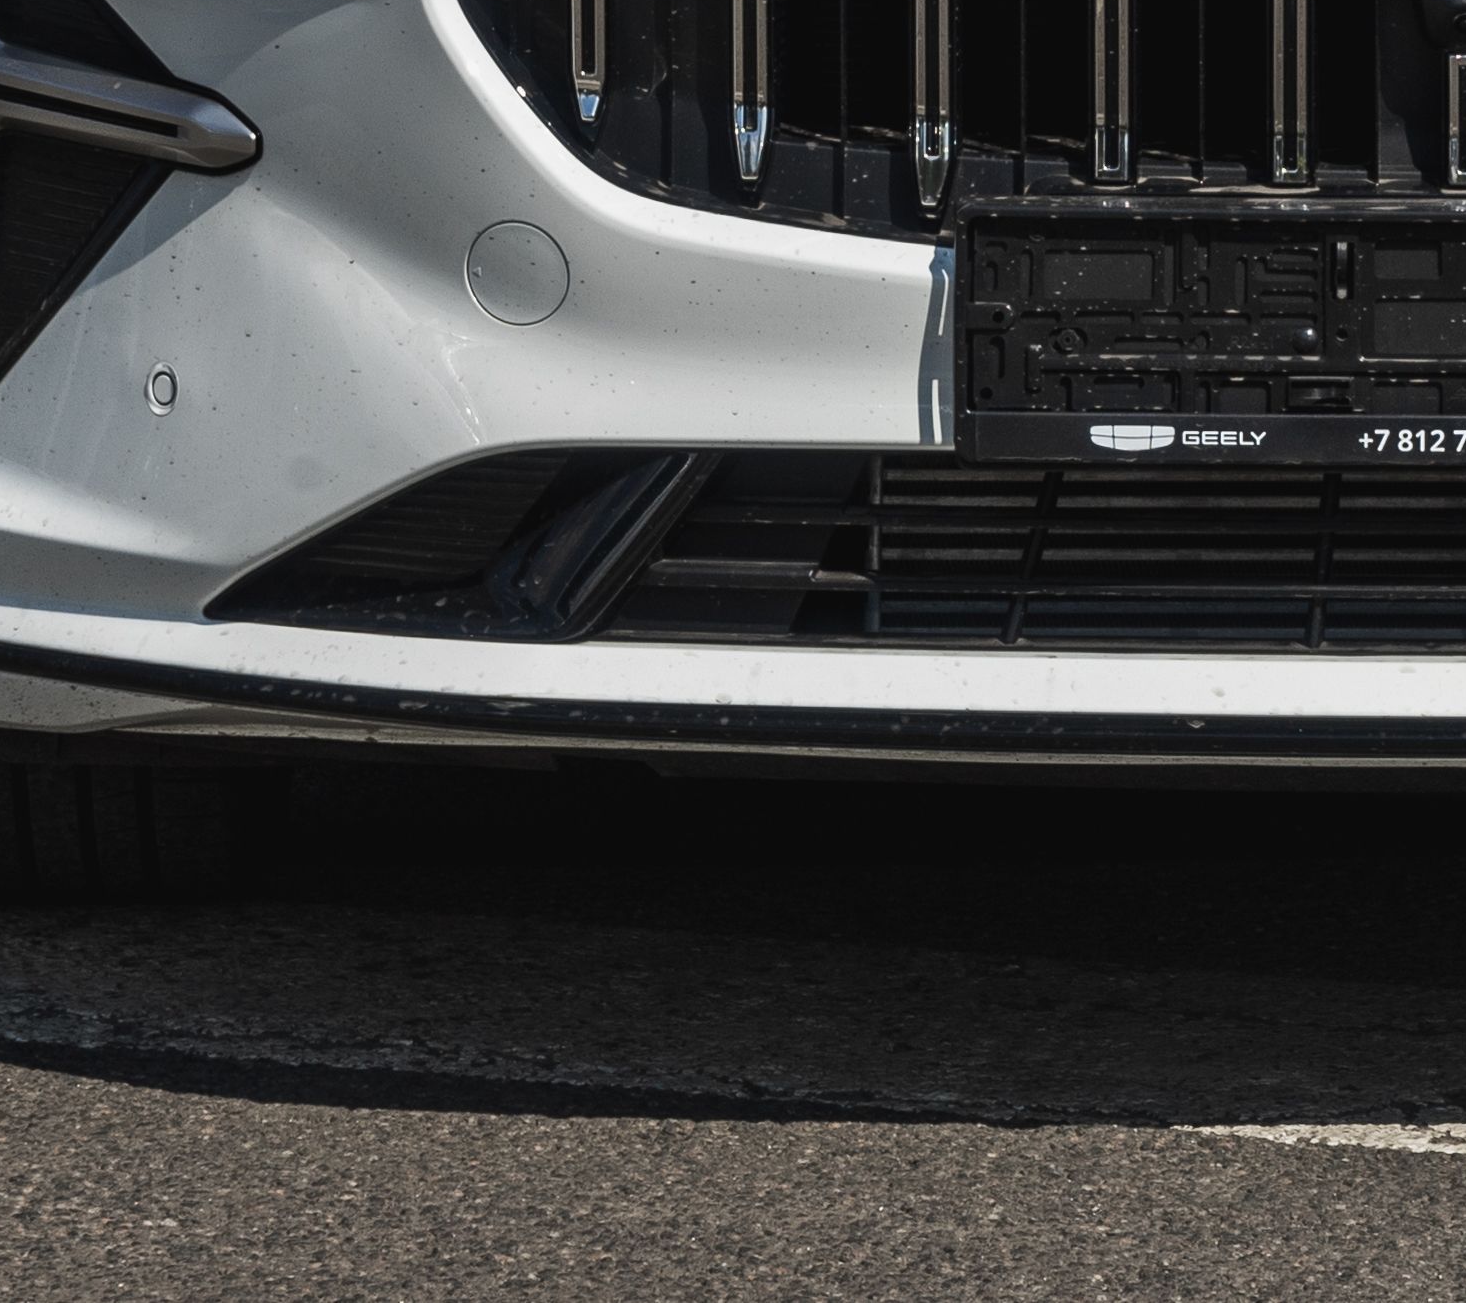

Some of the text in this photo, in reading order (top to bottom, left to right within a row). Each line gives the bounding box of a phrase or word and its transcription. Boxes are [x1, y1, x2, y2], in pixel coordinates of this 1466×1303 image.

[1181, 430, 1268, 446] GEELY
[1357, 428, 1391, 453] +7
[1397, 428, 1446, 453] 812
